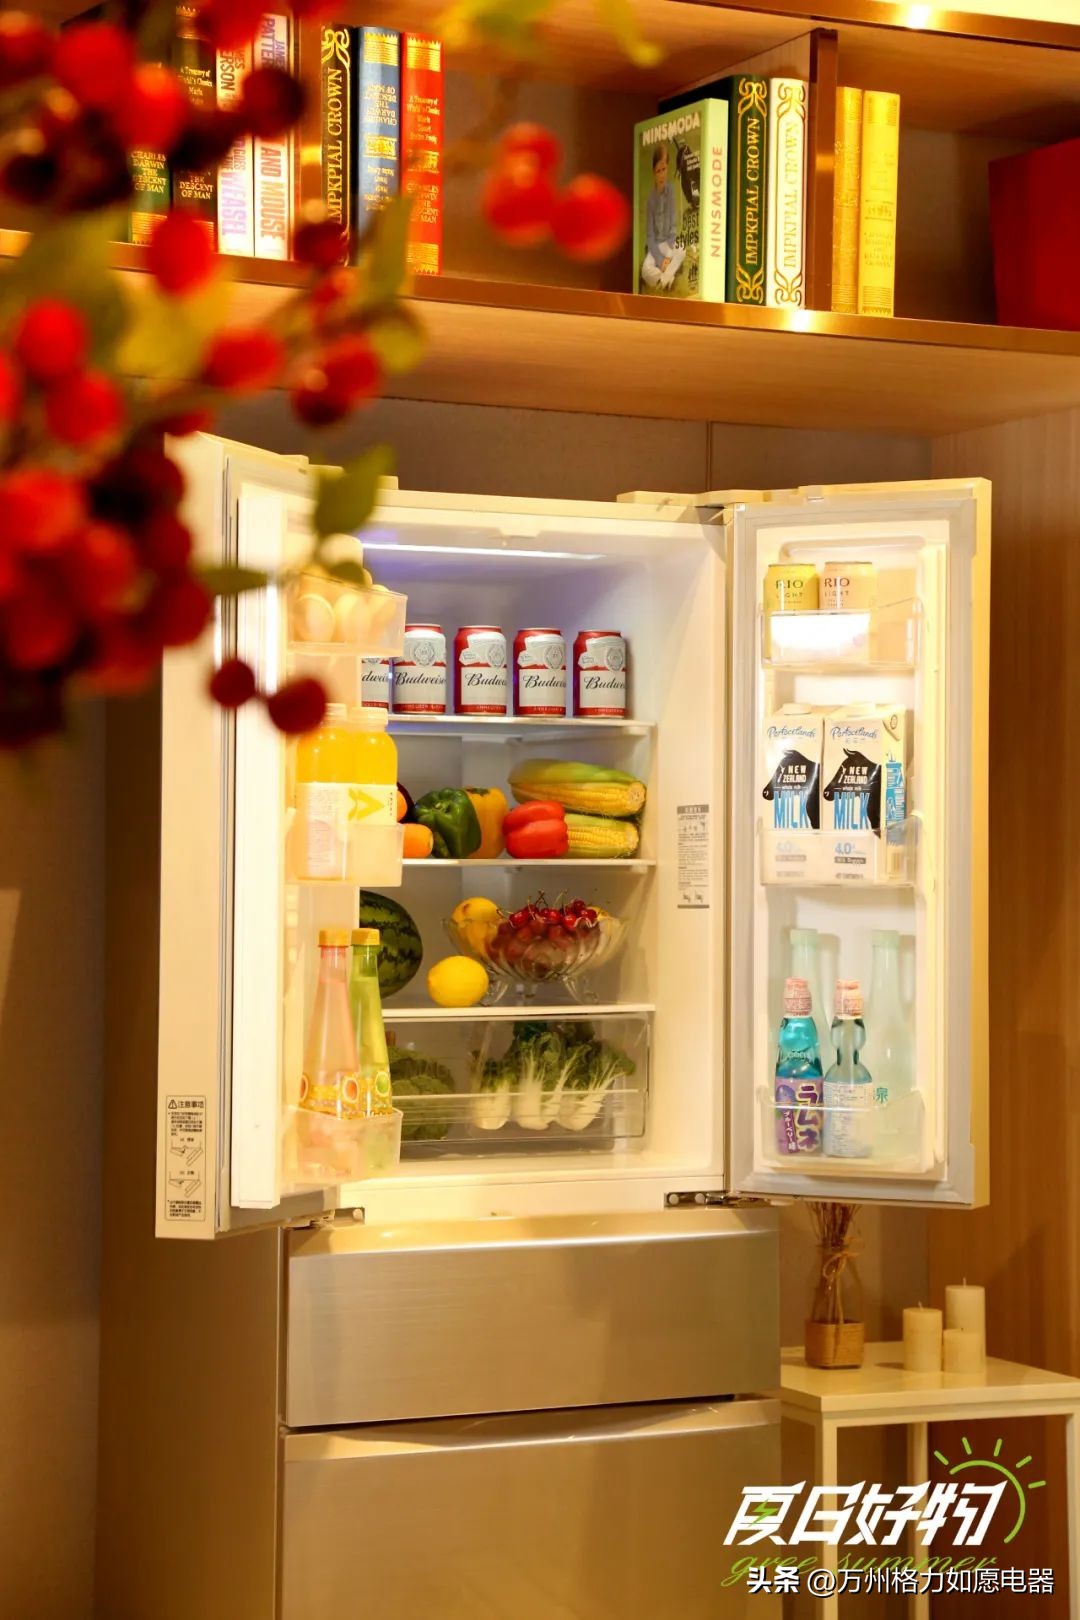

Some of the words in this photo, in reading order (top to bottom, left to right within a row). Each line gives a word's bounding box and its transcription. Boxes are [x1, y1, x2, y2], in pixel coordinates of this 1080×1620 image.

[220, 51, 235, 92] ERSON
[327, 67, 343, 137] CROWN
[642, 111, 701, 147] NINSMODA
[261, 146, 281, 177] AND
[746, 117, 760, 182] CROWN
[785, 121, 799, 185] CROWN
[146, 184, 164, 193] MAN
[179, 181, 214, 193] DESCENT
[181, 189, 193, 198] OF
[193, 190, 211, 200] MAN
[327, 139, 343, 225] MPKPIAL
[710, 145, 723, 258] NINSMODE
[221, 172, 247, 236] WEASEL
[261, 181, 285, 240] MOUSE
[682, 212, 699, 231] best
[675, 229, 699, 250] styles
[824, 577, 850, 588] RIO
[788, 765, 807, 774] NEW
[849, 766, 869, 775] NEW
[773, 790, 810, 829] MILK
[833, 791, 870, 830] MILK
[797, 1083, 819, 1152] ラムネ
